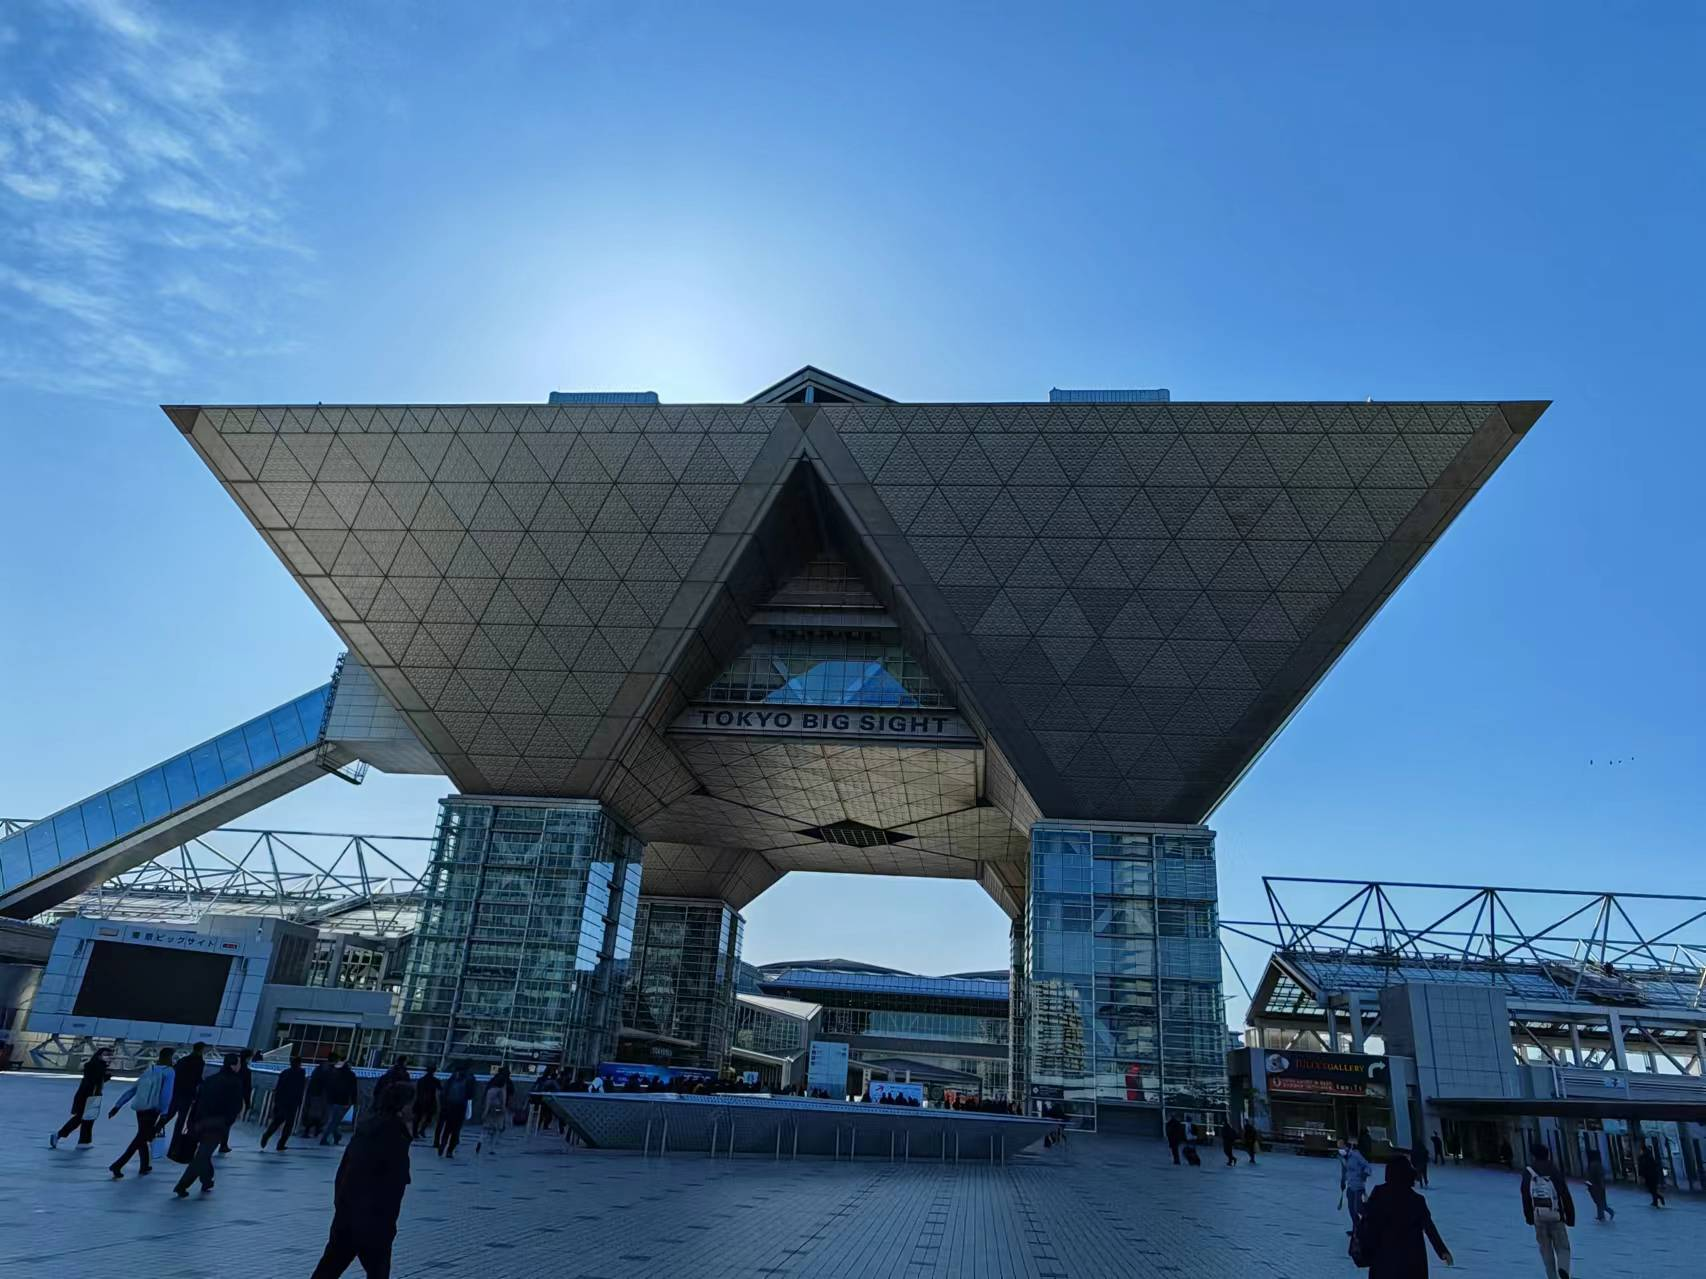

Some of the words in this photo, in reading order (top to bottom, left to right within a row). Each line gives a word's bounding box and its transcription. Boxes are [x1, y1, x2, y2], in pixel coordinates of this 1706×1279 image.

[699, 710, 793, 728] TOKYO
[802, 713, 850, 731] BIG
[859, 715, 950, 734] SIGHT
